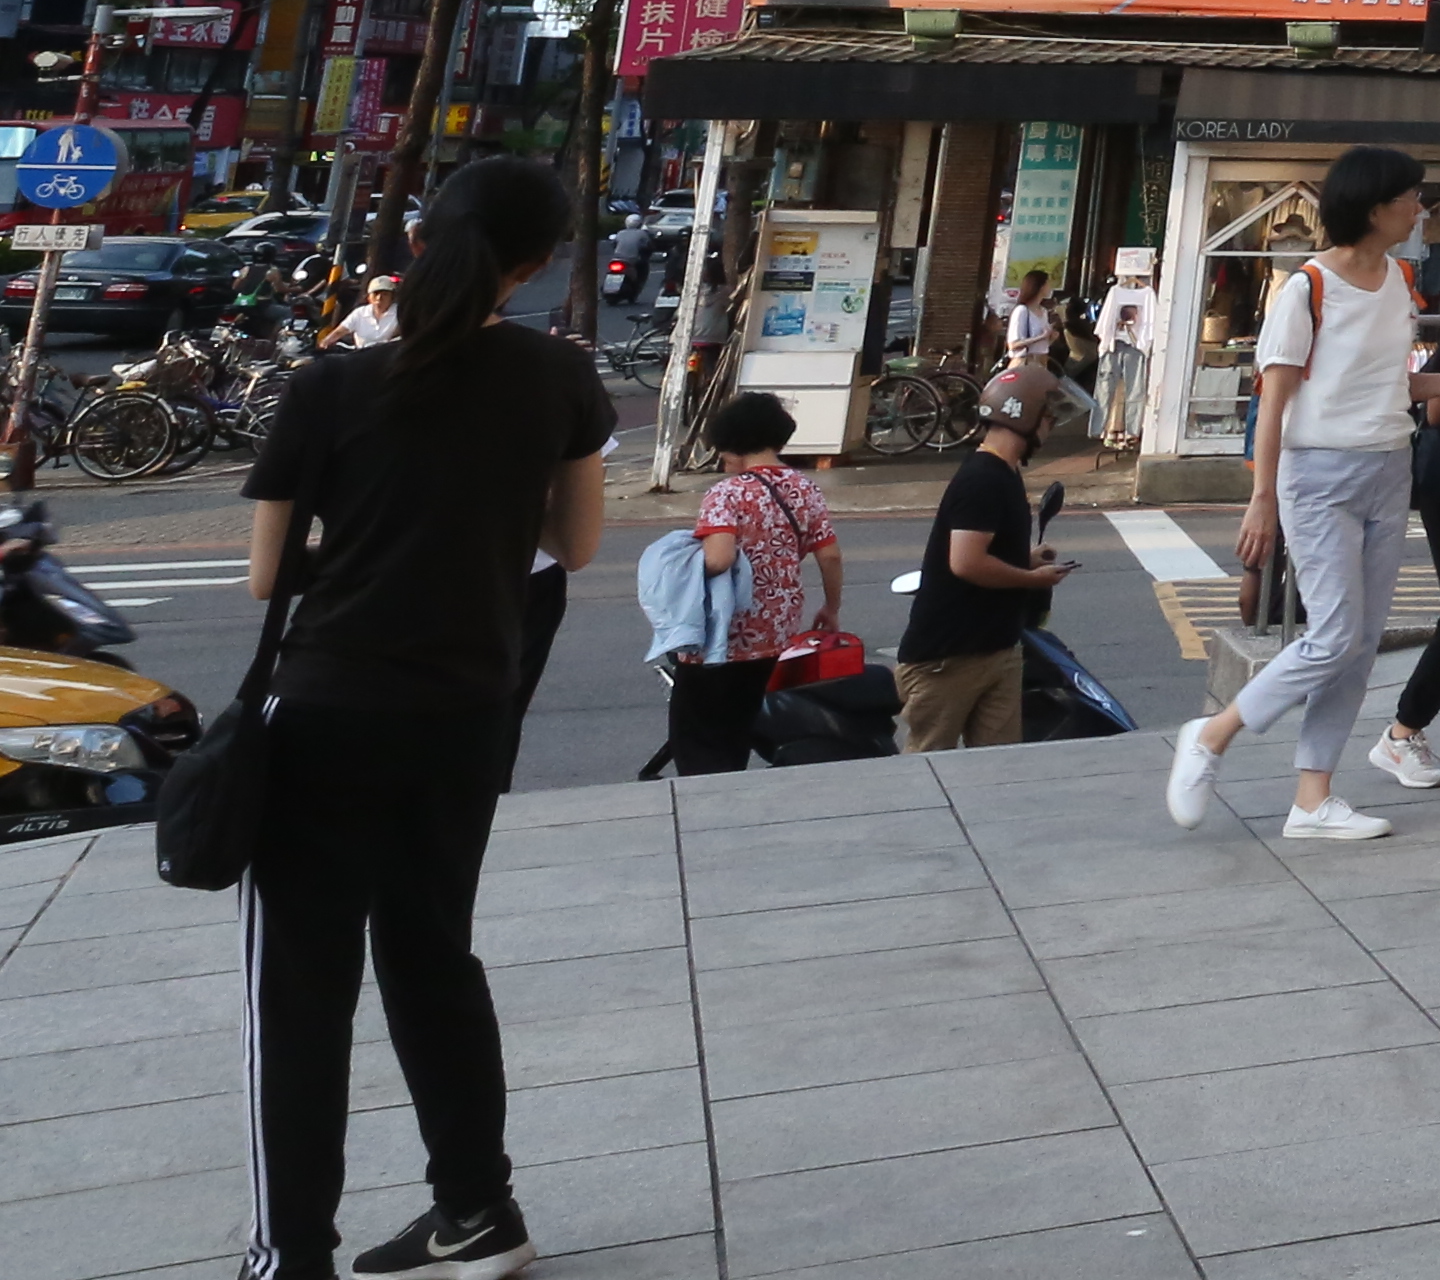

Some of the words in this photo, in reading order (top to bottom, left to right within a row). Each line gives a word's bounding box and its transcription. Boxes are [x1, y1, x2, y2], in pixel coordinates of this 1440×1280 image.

[1177, 121, 1239, 139] KOREA
[1247, 121, 1295, 139] LADY
[18, 226, 86, 241] 行人優先
